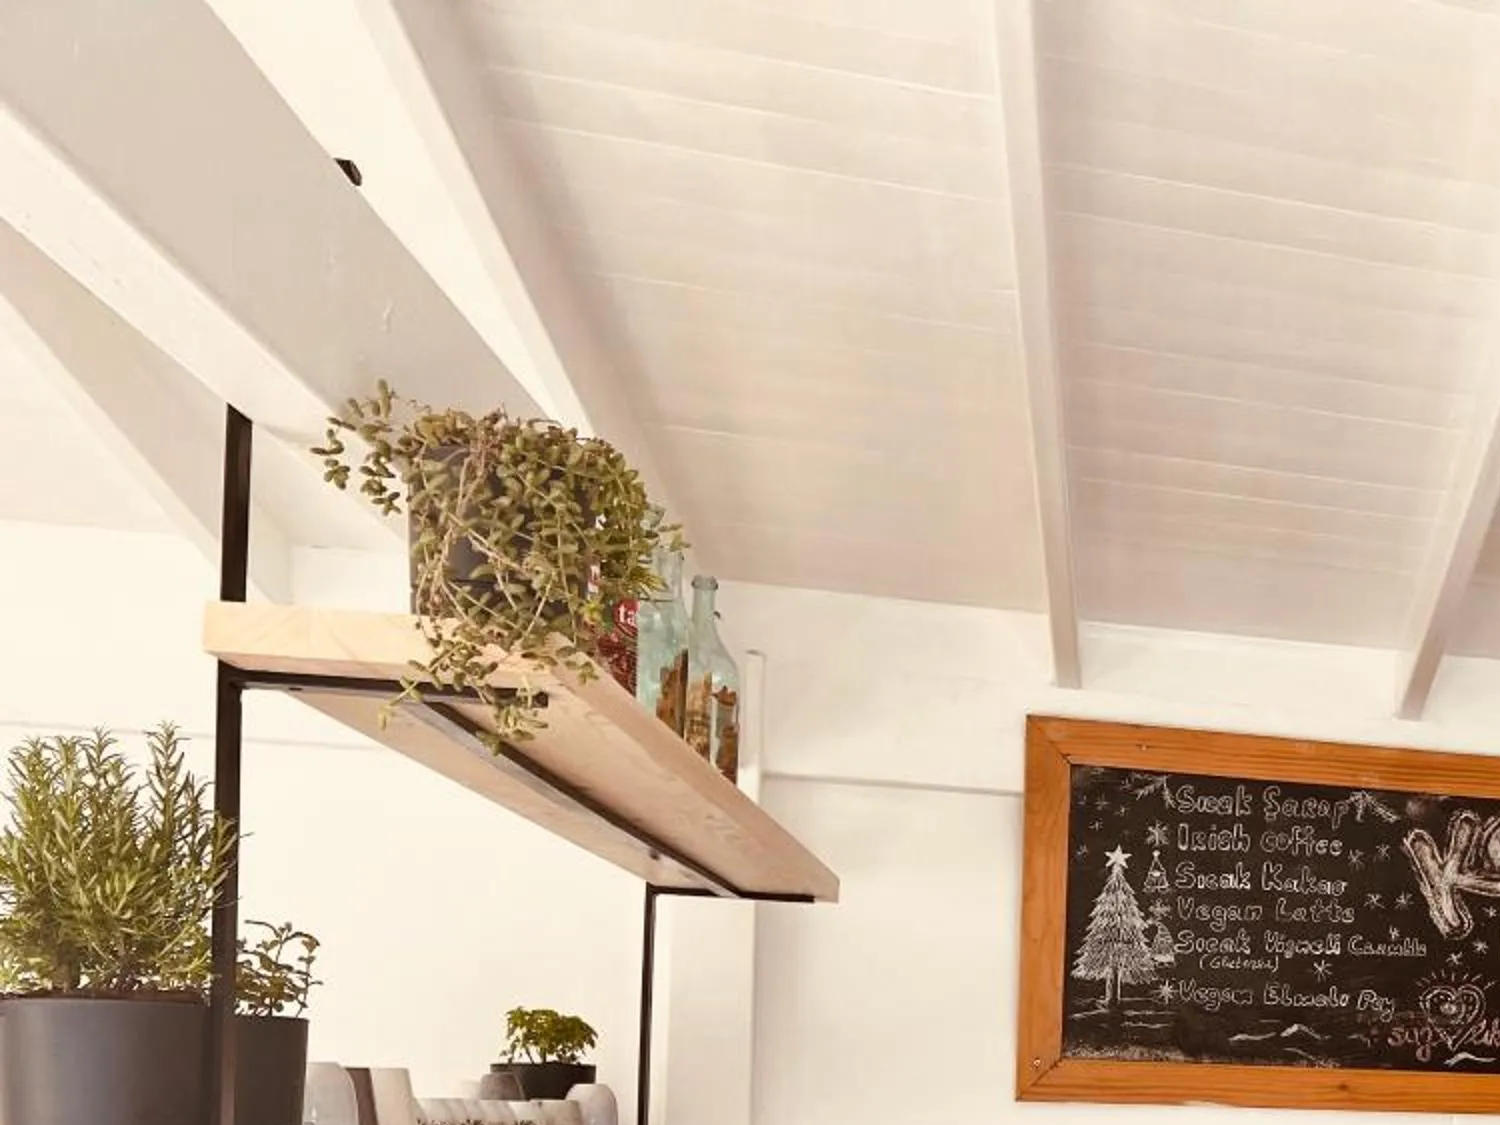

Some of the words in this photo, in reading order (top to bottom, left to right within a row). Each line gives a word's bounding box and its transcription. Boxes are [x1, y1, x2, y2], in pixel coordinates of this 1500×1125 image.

[1178, 823, 1250, 851] Irish
[1262, 861, 1348, 894] Kakao
[1177, 896, 1262, 930] Vegan
[1275, 898, 1355, 922] Latte
